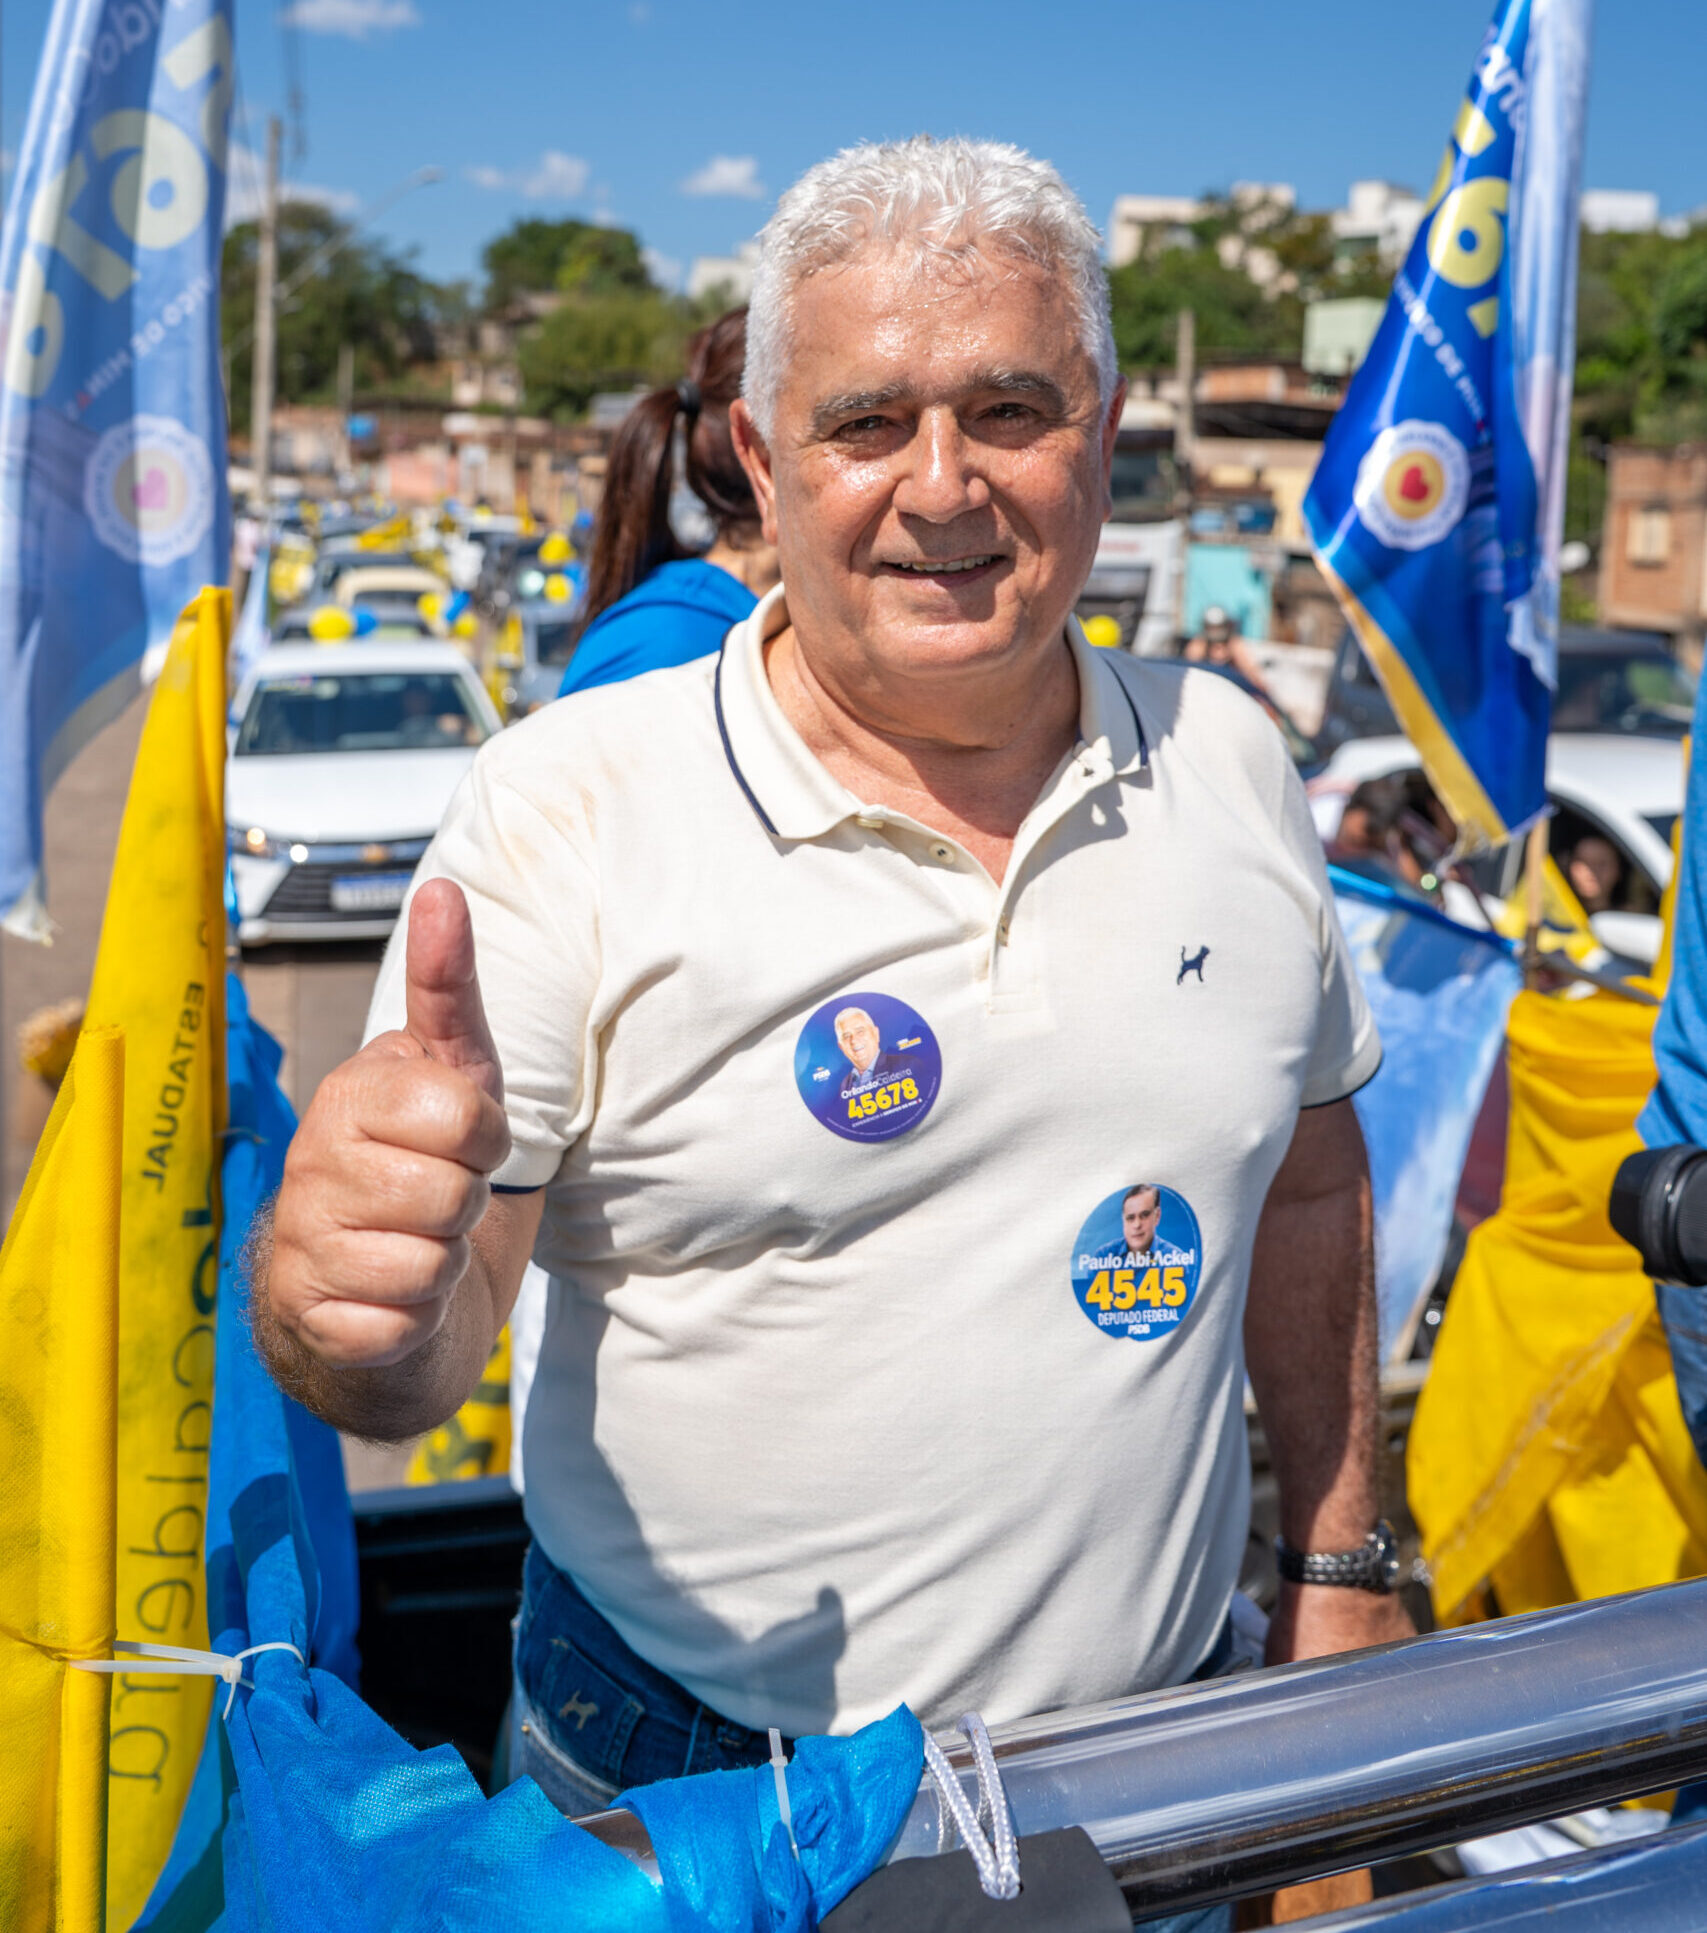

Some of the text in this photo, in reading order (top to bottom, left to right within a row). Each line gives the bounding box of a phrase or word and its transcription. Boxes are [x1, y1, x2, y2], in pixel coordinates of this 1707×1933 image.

[847, 1077, 919, 1119] 45678
[1078, 1252, 1122, 1270] Paulo
[1085, 1266, 1187, 1311] 4545
[1097, 1308, 1180, 1326] DEPUTADO FEDERAL
